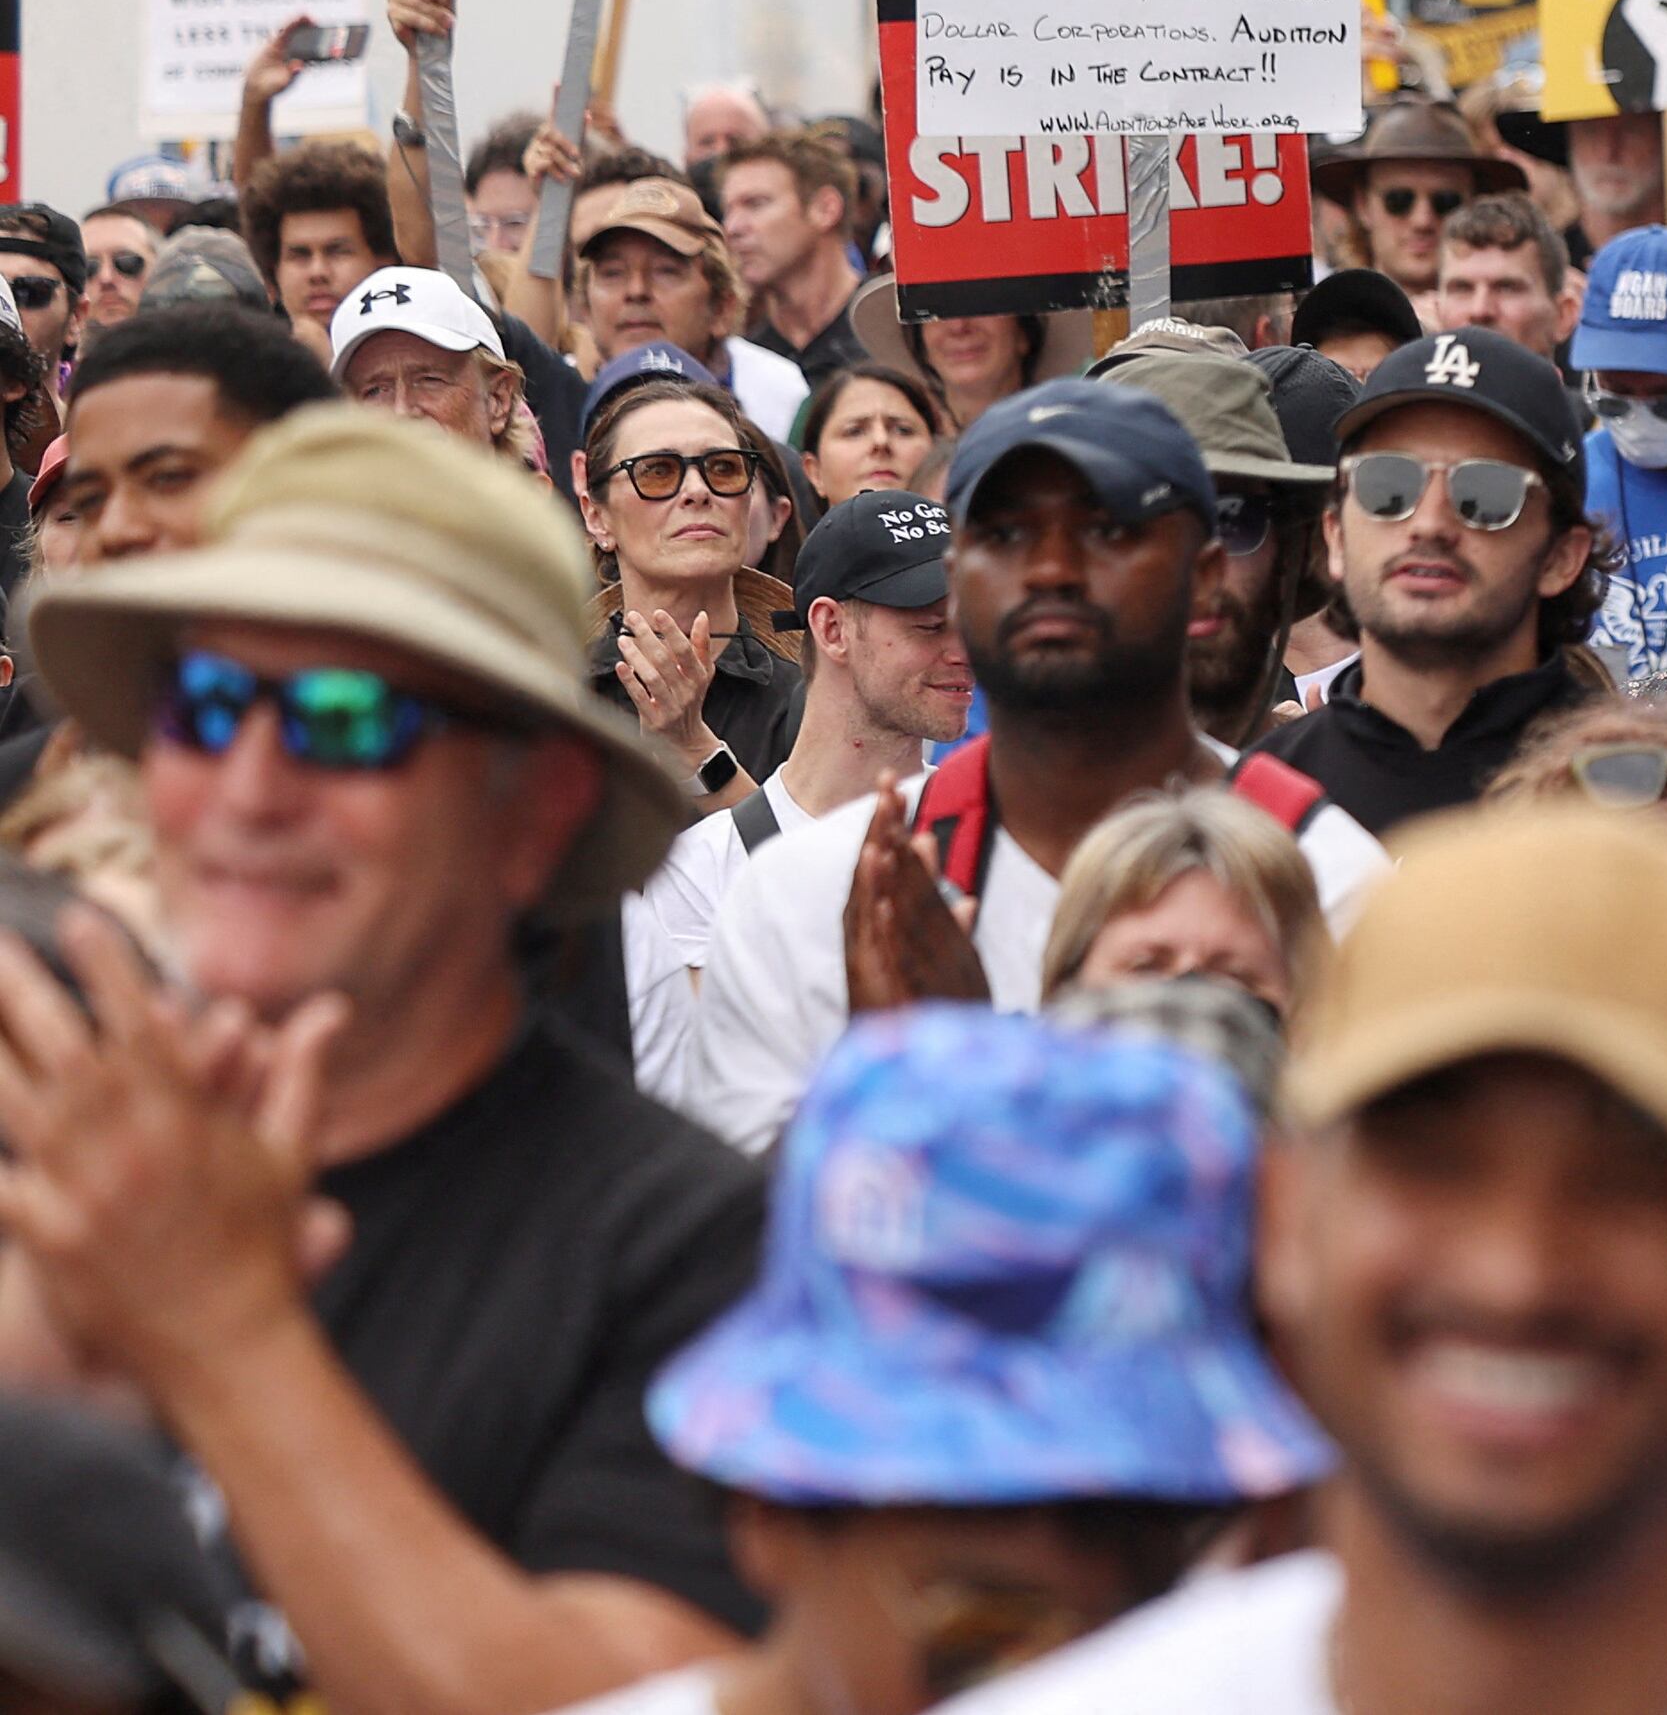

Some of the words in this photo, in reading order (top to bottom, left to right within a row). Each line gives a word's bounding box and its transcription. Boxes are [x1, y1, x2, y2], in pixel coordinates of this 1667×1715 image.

[922, 13, 1019, 41] DOLLAR
[1230, 15, 1347, 45] AUDITION
[925, 55, 976, 96] PAY
[999, 63, 1024, 88] IS
[1050, 62, 1076, 86] IN
[1088, 64, 1128, 85] THE
[1424, 333, 1481, 389] LA
[877, 509, 914, 528] No
[889, 525, 925, 544] No
